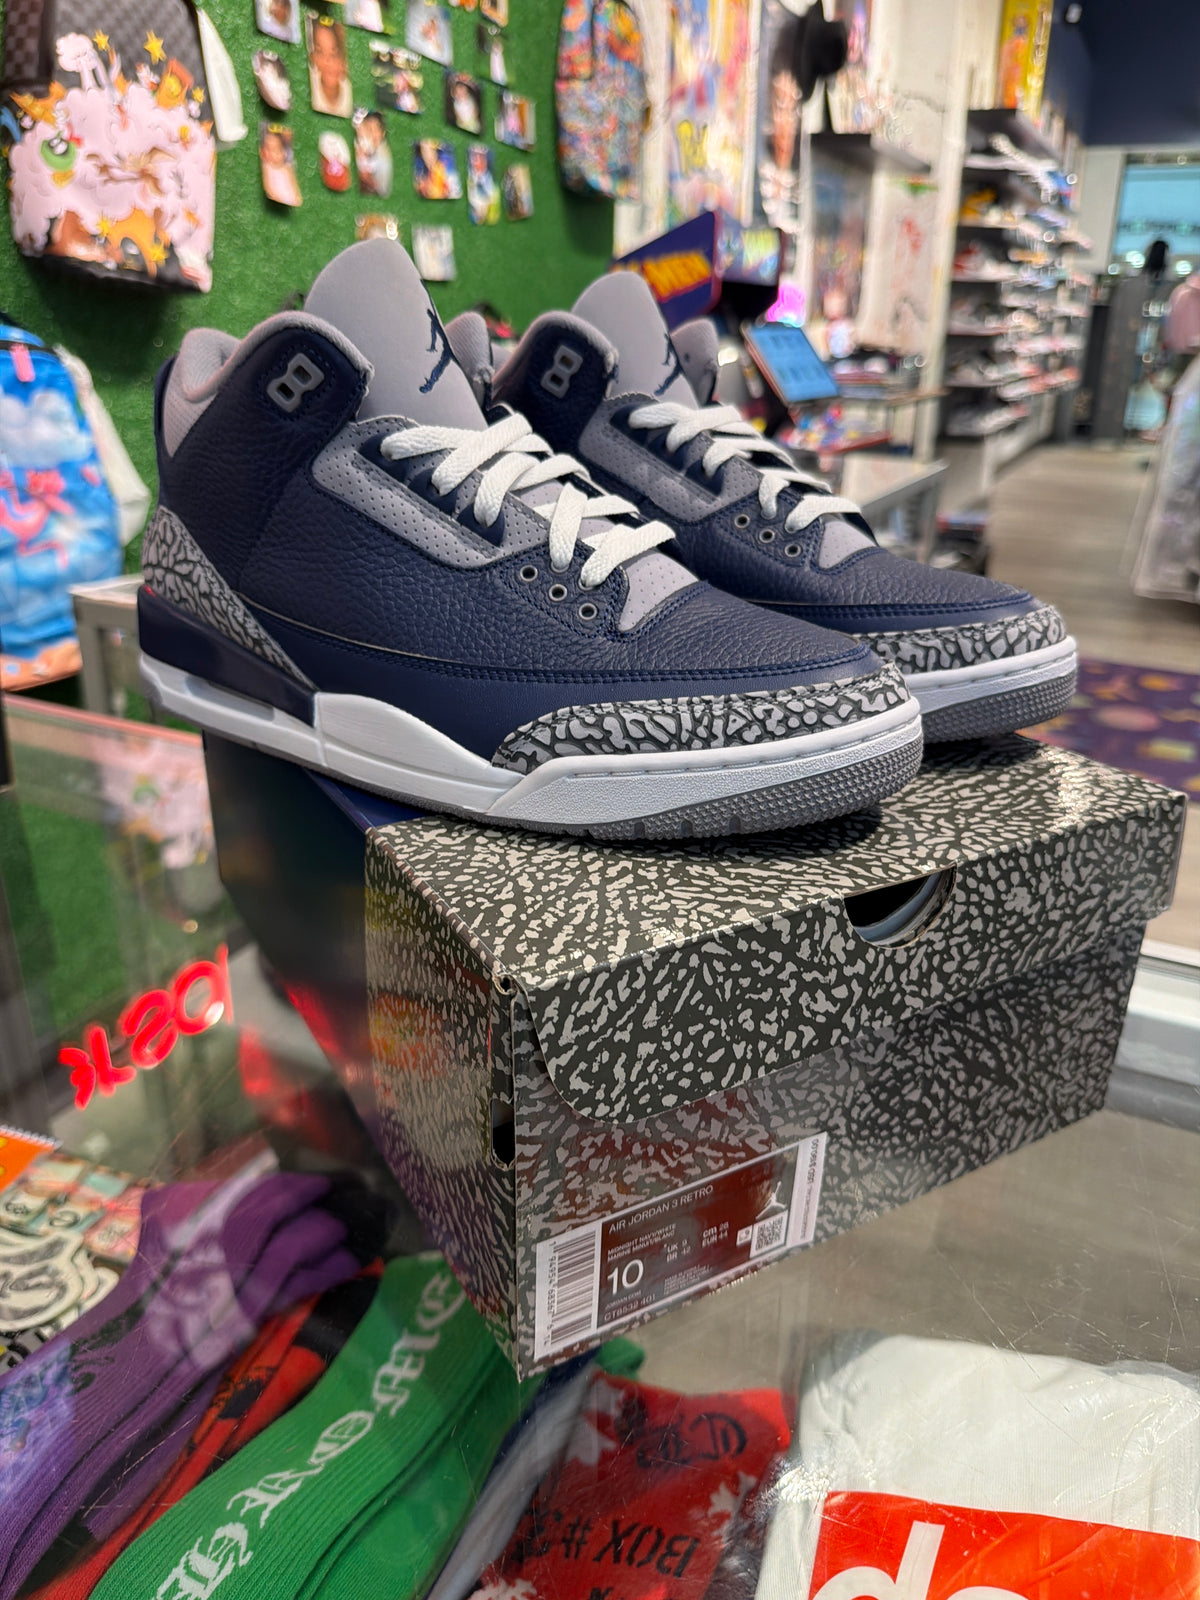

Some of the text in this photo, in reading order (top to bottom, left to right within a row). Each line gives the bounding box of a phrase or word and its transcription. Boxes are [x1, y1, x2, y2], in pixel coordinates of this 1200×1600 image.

[609, 1185, 714, 1235] AIR JORDAN 3 RETRO
[702, 1226, 717, 1237] cm
[607, 1259, 644, 1295] 10
[591, 1519, 701, 1579] BOX
